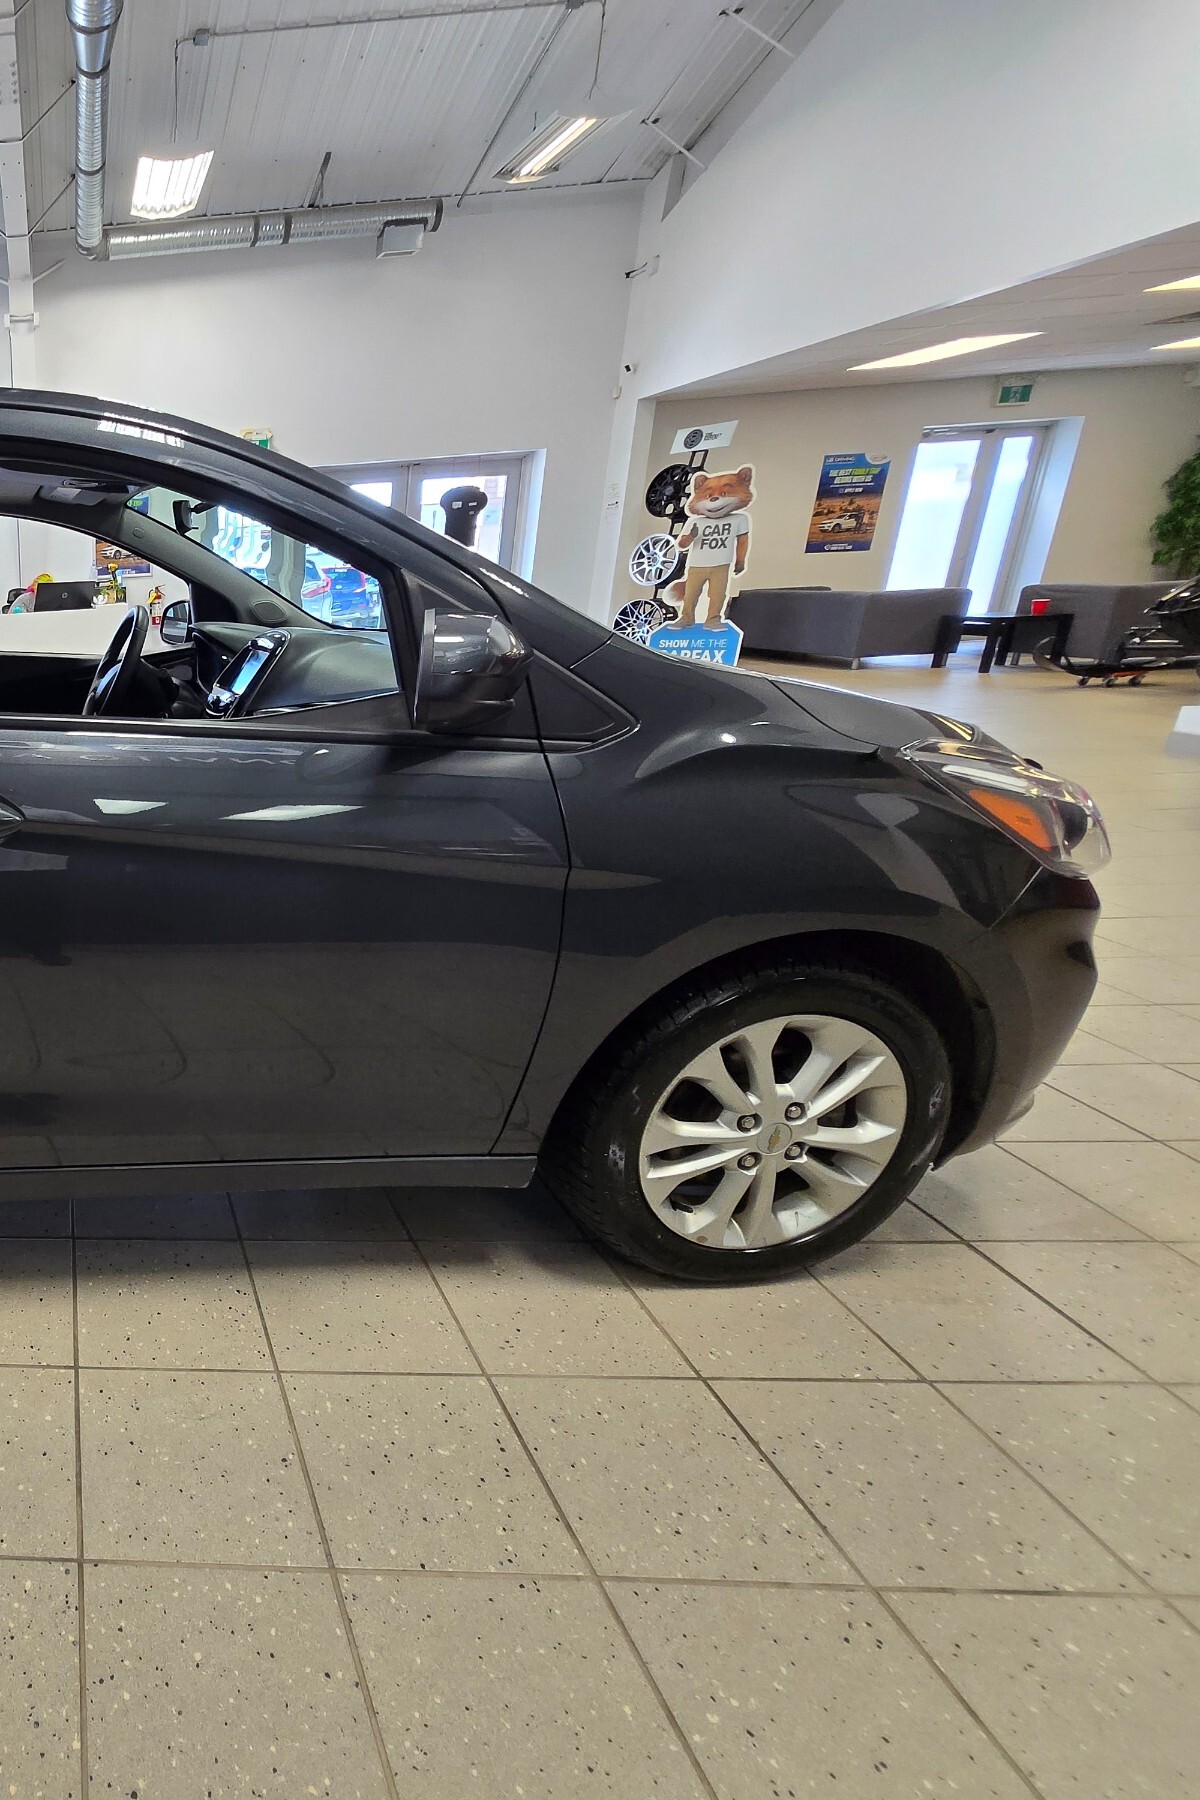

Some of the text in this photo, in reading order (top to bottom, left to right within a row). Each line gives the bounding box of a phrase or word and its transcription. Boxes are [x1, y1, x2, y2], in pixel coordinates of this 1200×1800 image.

[702, 523, 732, 537] CAR
[700, 536, 728, 550] FOX
[659, 639, 727, 648] SHOW ME THE
